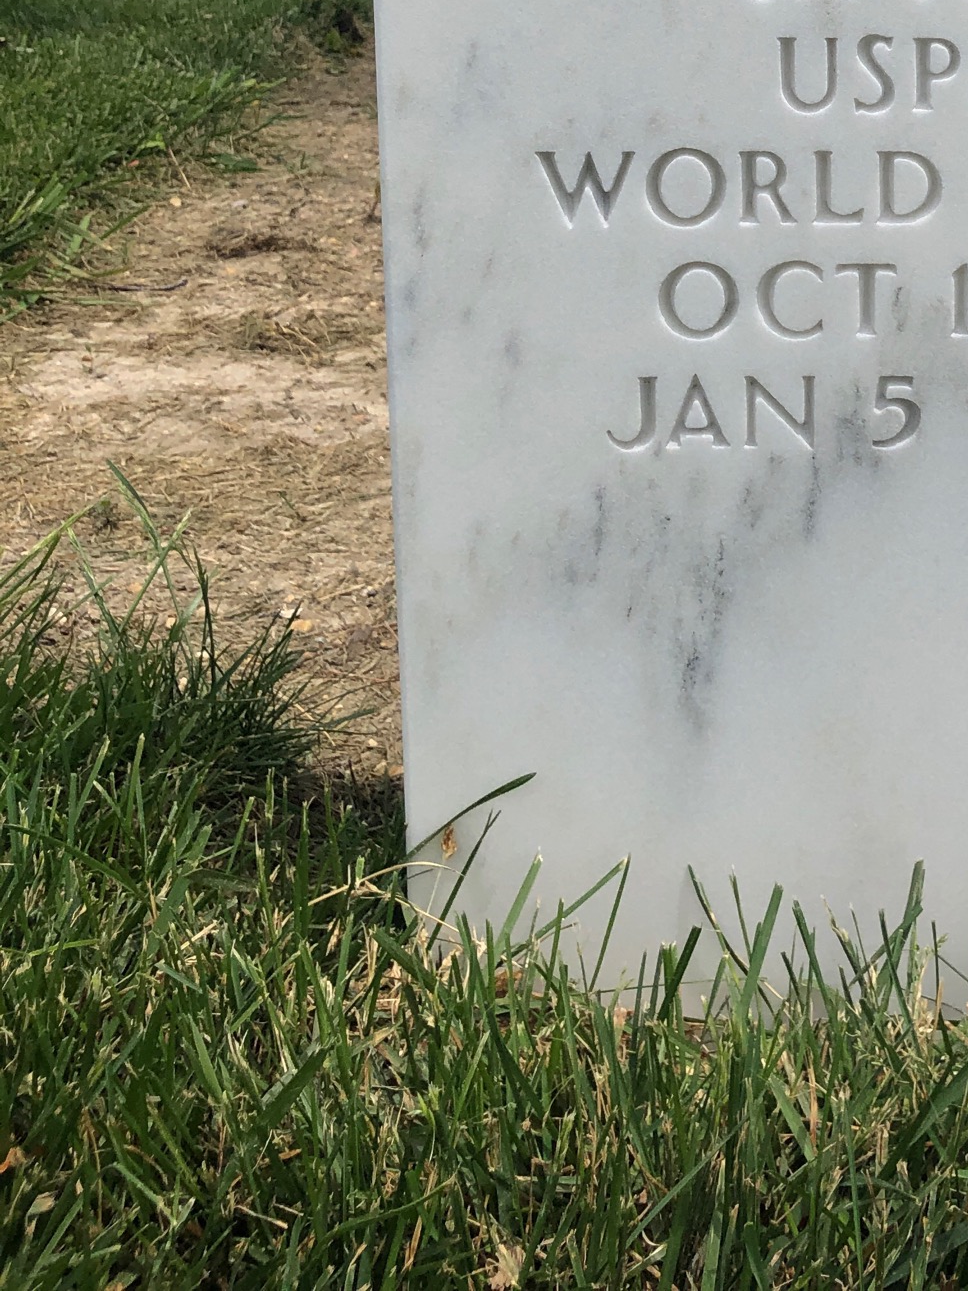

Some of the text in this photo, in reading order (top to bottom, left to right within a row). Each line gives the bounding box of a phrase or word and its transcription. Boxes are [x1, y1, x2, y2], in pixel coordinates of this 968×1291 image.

[534, 147, 943, 228] WORLD
[657, 260, 897, 342] OCT
[606, 373, 817, 452] JAN
[870, 375, 923, 450] 5
